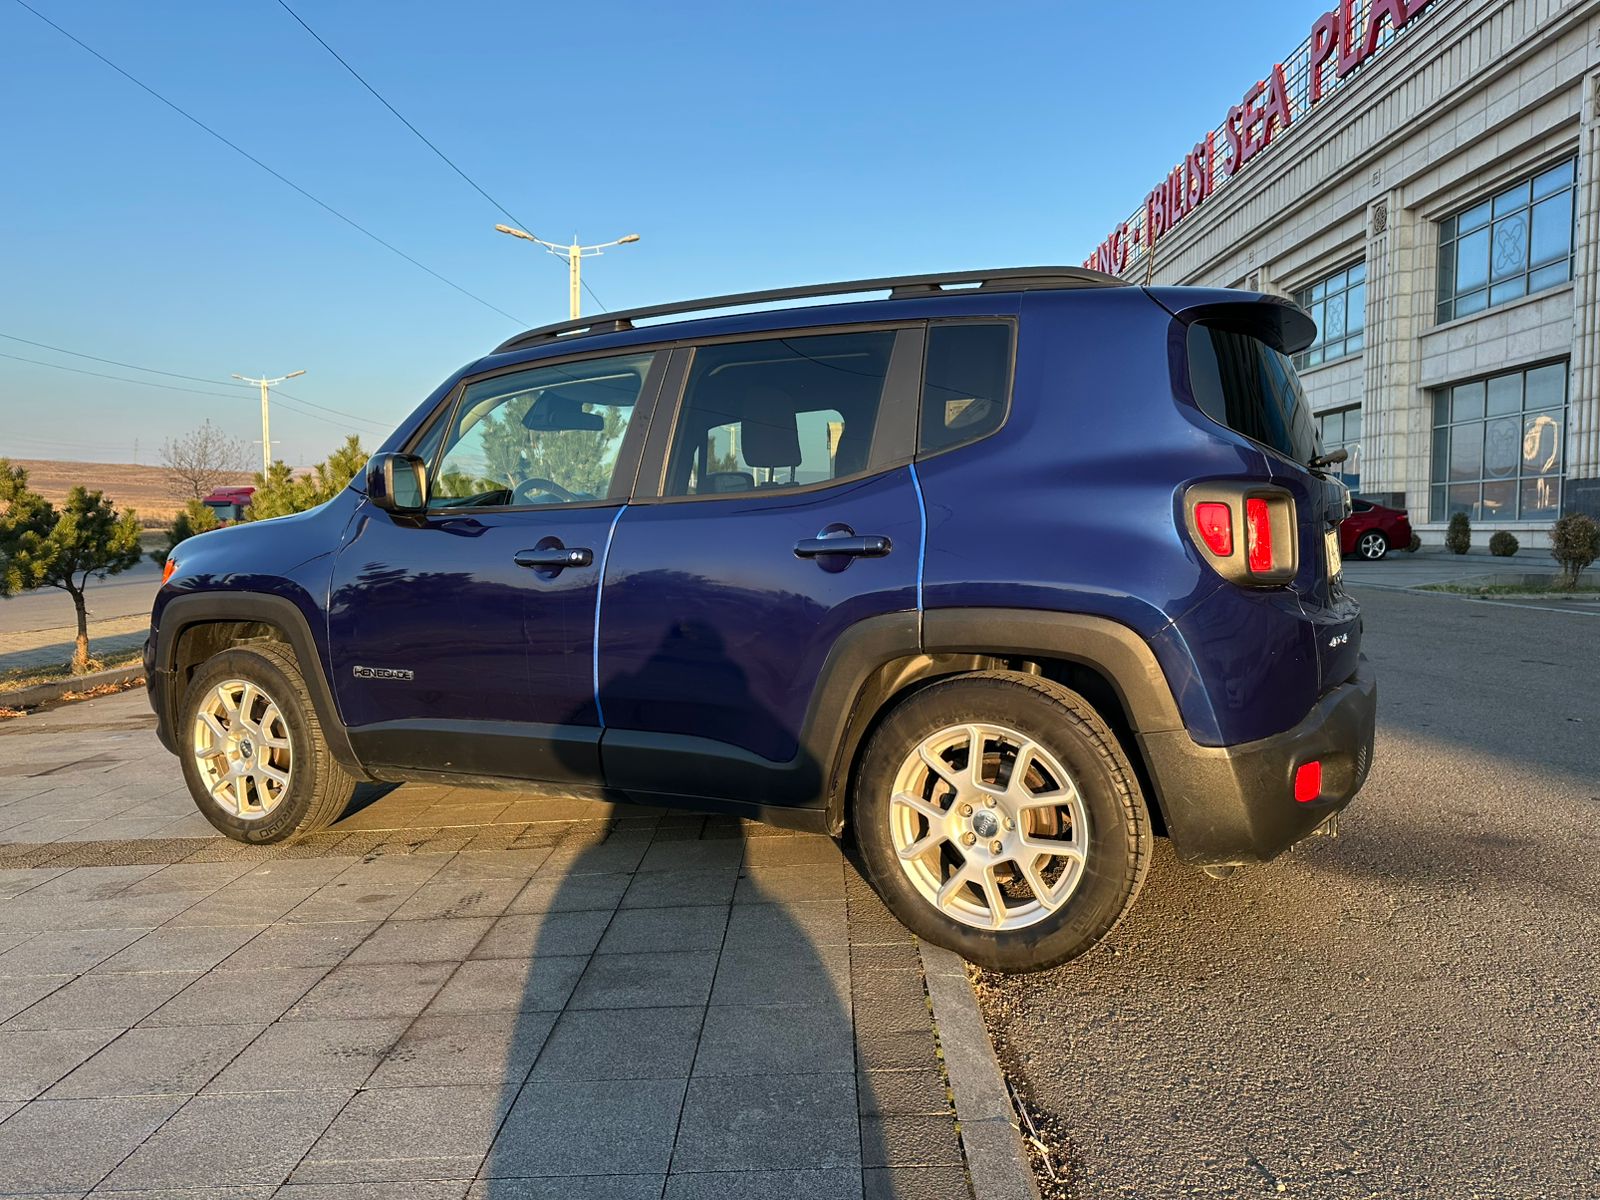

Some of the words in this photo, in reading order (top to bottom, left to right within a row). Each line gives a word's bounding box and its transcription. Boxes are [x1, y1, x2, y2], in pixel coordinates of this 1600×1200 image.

[1144, 131, 1214, 246] TBILISI
[1223, 64, 1291, 175] SEA
[353, 665, 414, 680] RENEGADE
